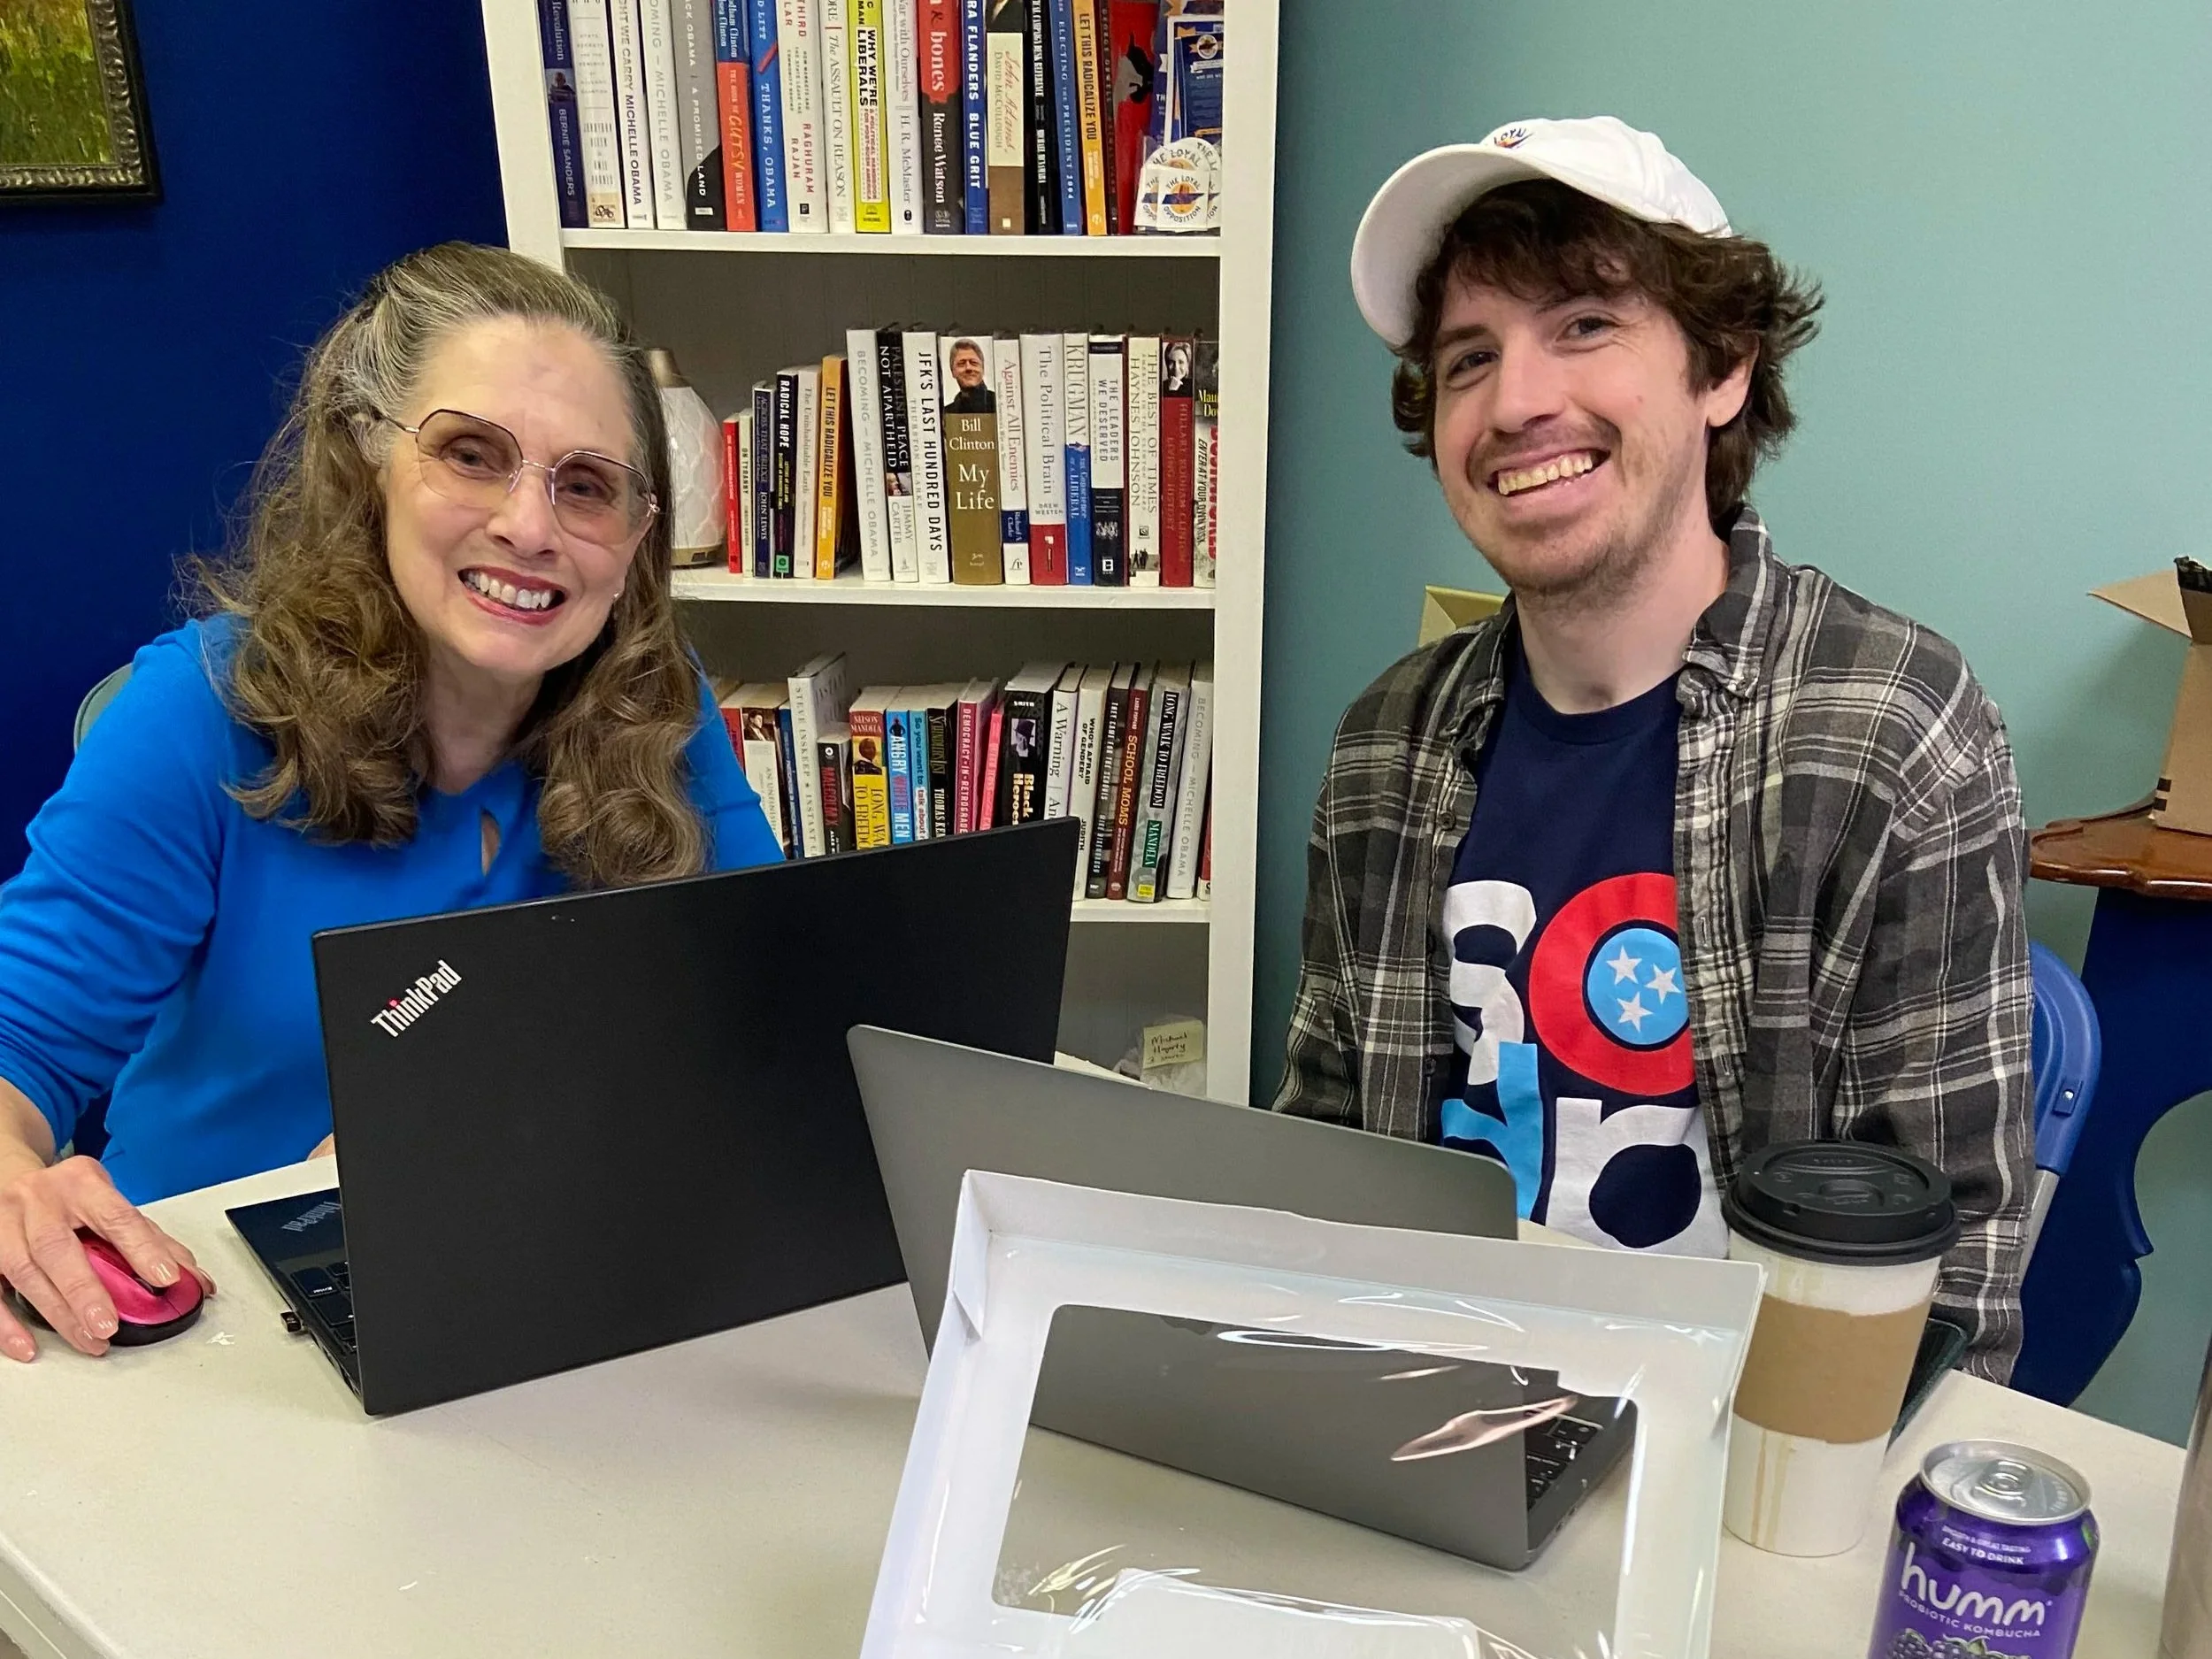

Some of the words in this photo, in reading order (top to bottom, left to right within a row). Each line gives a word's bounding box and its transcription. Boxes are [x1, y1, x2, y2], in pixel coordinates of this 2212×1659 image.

[719, 17, 728, 47] Clinton
[757, 12, 767, 40] LITT
[900, 19, 910, 42] with
[1079, 13, 1091, 31] LET
[687, 26, 696, 66] OBAMA
[730, 28, 739, 58] Clinton
[829, 35, 840, 56] The
[867, 29, 876, 60] WHY
[930, 31, 948, 92] bones
[1058, 21, 1068, 81] ELECTING
[1081, 35, 1093, 57] THIS
[622, 49, 634, 92] CARRY
[857, 29, 868, 106] LIBERALS
[901, 47, 911, 103] Ourselves
[968, 26, 979, 100] FLANDERS
[1004, 50, 1020, 89] John
[829, 58, 842, 113] ASSAULT
[869, 65, 878, 106] WE'RE
[1083, 61, 1096, 118] RADICALIZE
[626, 94, 639, 157] MICHELLE
[656, 70, 669, 142] MICHELLE
[761, 82, 773, 151] THANKS,
[558, 108, 571, 145] BERNIE
[693, 100, 703, 160] PROMISED
[833, 119, 843, 139] ON
[969, 112, 980, 150] BLUE
[1062, 104, 1073, 168] PRESIDENT
[1087, 120, 1097, 141] YOU
[563, 148, 575, 196] SANDERS
[660, 149, 673, 202] OBAMA
[791, 137, 801, 179] RAJAN
[803, 123, 815, 193] RAGHURAM
[833, 143, 846, 197] REASON
[902, 148, 913, 204] McMaster
[970, 156, 980, 189] GRIT
[630, 159, 642, 205] OBAMA
[697, 165, 707, 196] LAND
[764, 157, 777, 208] OBAMA
[934, 154, 948, 204] Watson
[1181, 174, 1202, 191] LOYAL
[1163, 204, 1202, 223] OPPOSITION
[879, 346, 891, 378] NOT
[918, 352, 933, 390] JFK'S
[1039, 345, 1052, 379] The
[1148, 350, 1157, 385] THE
[780, 380, 790, 420] RADICAL
[826, 387, 836, 403] LET
[856, 349, 870, 422] BECOMING
[892, 346, 906, 421] PALESTINE
[1001, 358, 1018, 411] Against
[1065, 344, 1087, 436] KRUGMAN
[1098, 380, 1108, 396] WE
[1109, 379, 1118, 401] THE
[1130, 357, 1141, 424] HAYNES
[825, 406, 835, 427] THIS
[882, 385, 897, 467] APARTHEID
[921, 398, 936, 434] LAST
[961, 418, 981, 432] Bill
[1007, 412, 1021, 433] All
[1040, 384, 1055, 449] Political
[1148, 392, 1157, 428] BEST
[1178, 403, 1188, 452] HILLARY
[779, 423, 790, 449] HOPE
[896, 426, 909, 466] PEACE
[949, 436, 995, 450] Clinton
[1098, 402, 1109, 462] DESERVED
[1109, 408, 1119, 461] LEADERS
[1148, 437, 1157, 458] OF
[823, 428, 834, 479] RADICALIZE
[1008, 436, 1022, 492] Enemies
[1130, 431, 1141, 507] JOHNSON
[1197, 439, 1208, 465] ENTER
[822, 480, 833, 497] YOU
[864, 442, 875, 503] MICHELLE
[924, 441, 940, 509] HUNDRED
[958, 464, 989, 488] My
[1041, 454, 1055, 494] Brain
[1148, 461, 1157, 514] TIMES
[1197, 480, 1207, 503] YOUR
[759, 491, 768, 516] JOHN
[956, 489, 995, 510] Life
[1070, 474, 1079, 518] LIBERAL
[760, 518, 769, 540] LEWIS
[868, 511, 879, 557] OBAMA
[891, 502, 902, 544] CARTER
[902, 504, 914, 541] JIMMY
[929, 517, 942, 551] DAYS
[853, 715, 879, 724] NELSON
[914, 717, 922, 730] So
[1056, 703, 1069, 714] A
[1164, 694, 1177, 718] LONG
[850, 724, 882, 733] MANDELA
[913, 732, 922, 749] you
[961, 708, 972, 760] DEMOCRACY
[1048, 717, 1069, 777] Warning
[1082, 723, 1088, 736] OF
[1160, 722, 1173, 747] WALK
[1192, 697, 1207, 760] BECOMING
[889, 735, 907, 774] ANGRY
[916, 751, 925, 775] want
[1079, 738, 1087, 780] GENDER?
[1124, 734, 1138, 784] SCHOOL
[1158, 750, 1169, 762] TO
[798, 728, 810, 777] INSKEEP
[805, 794, 818, 841] INSTANT
[821, 767, 838, 816] MALCOLM
[855, 786, 868, 802] TO
[892, 775, 908, 811] WHITE
[917, 775, 924, 785] to
[917, 789, 926, 806] talk
[1023, 773, 1034, 818] Black
[1152, 764, 1168, 807] FREEDOM
[871, 787, 886, 819] LONG
[917, 807, 927, 833] about
[934, 787, 946, 819] THOMAS
[959, 780, 970, 834] RETROGRADE
[1118, 787, 1132, 826] MOMS
[1182, 777, 1197, 832] MICHELLE
[894, 812, 910, 838] MEN
[1079, 818, 1087, 851] JUDITH
[1145, 822, 1160, 865] MANDELA
[1177, 837, 1189, 877] OBAMA
[370, 959, 463, 1038] ThinkPad
[1942, 1537, 1969, 1554] EASY
[1970, 1547, 1987, 1559] TO
[1987, 1552, 2024, 1566] DRINK
[1901, 1541, 2046, 1627] humm
[1899, 1589, 1960, 1629] PROBIOTIC
[1963, 1623, 2041, 1639] KOMBUCHA
